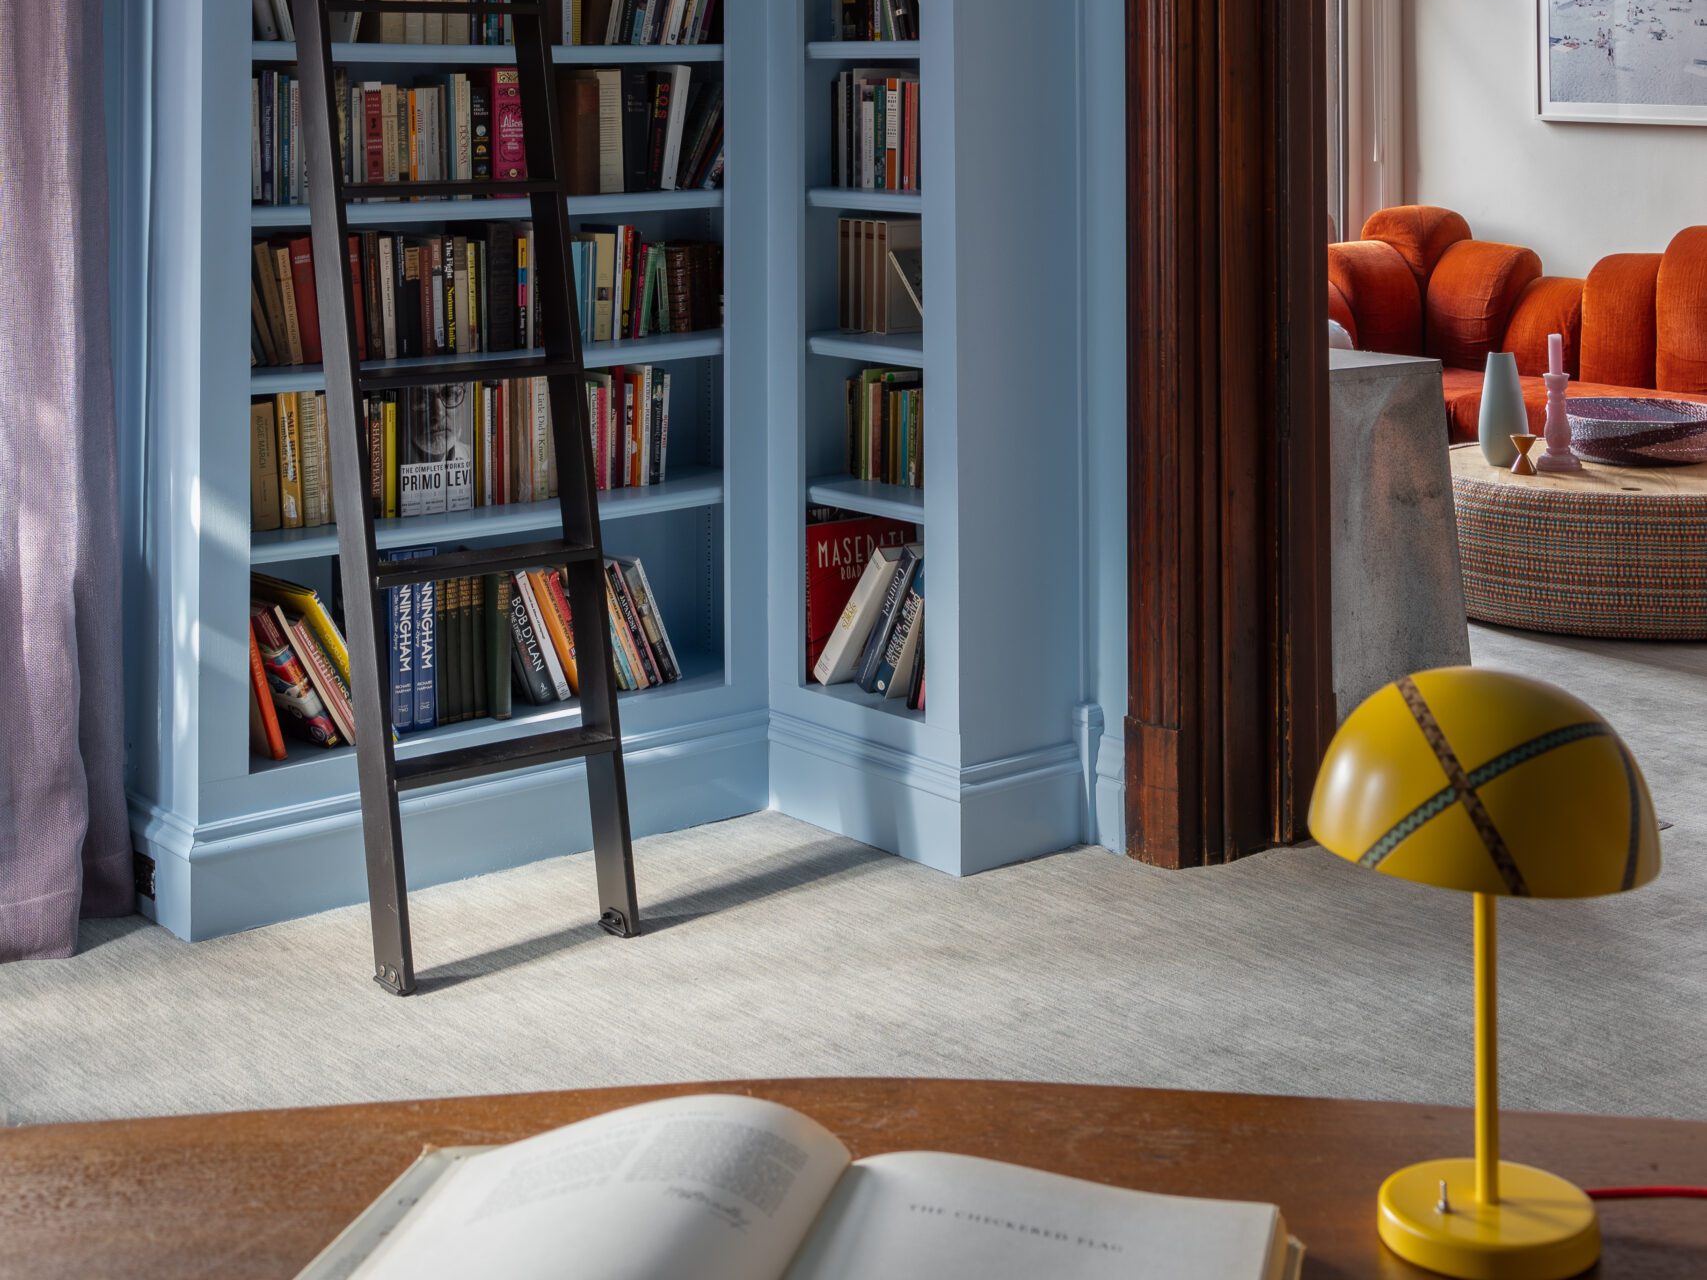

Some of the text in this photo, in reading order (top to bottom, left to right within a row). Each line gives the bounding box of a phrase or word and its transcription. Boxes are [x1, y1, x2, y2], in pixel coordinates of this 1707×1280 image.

[444, 258, 453, 279] Fight
[676, 269, 684, 292] House
[678, 294, 686, 313] Book
[448, 322, 456, 348] Mailer
[537, 393, 545, 414] Little
[256, 416, 267, 469] AUGIE MARCH
[537, 416, 545, 431] Did
[287, 411, 298, 483] SAUL BELLOW
[372, 422, 380, 495] SHAKESPEARE
[402, 473, 441, 491] PRIMO
[415, 465, 443, 473] COMPLETE
[881, 567, 905, 617] Courbet
[399, 585, 412, 672] NNINGHAM
[421, 582, 433, 669] NNINGHAM
[619, 594, 637, 632] JAPANESE
[511, 596, 544, 672] BOB DYLAN
[907, 1203, 1126, 1254] THE CHECKERED FLAG
